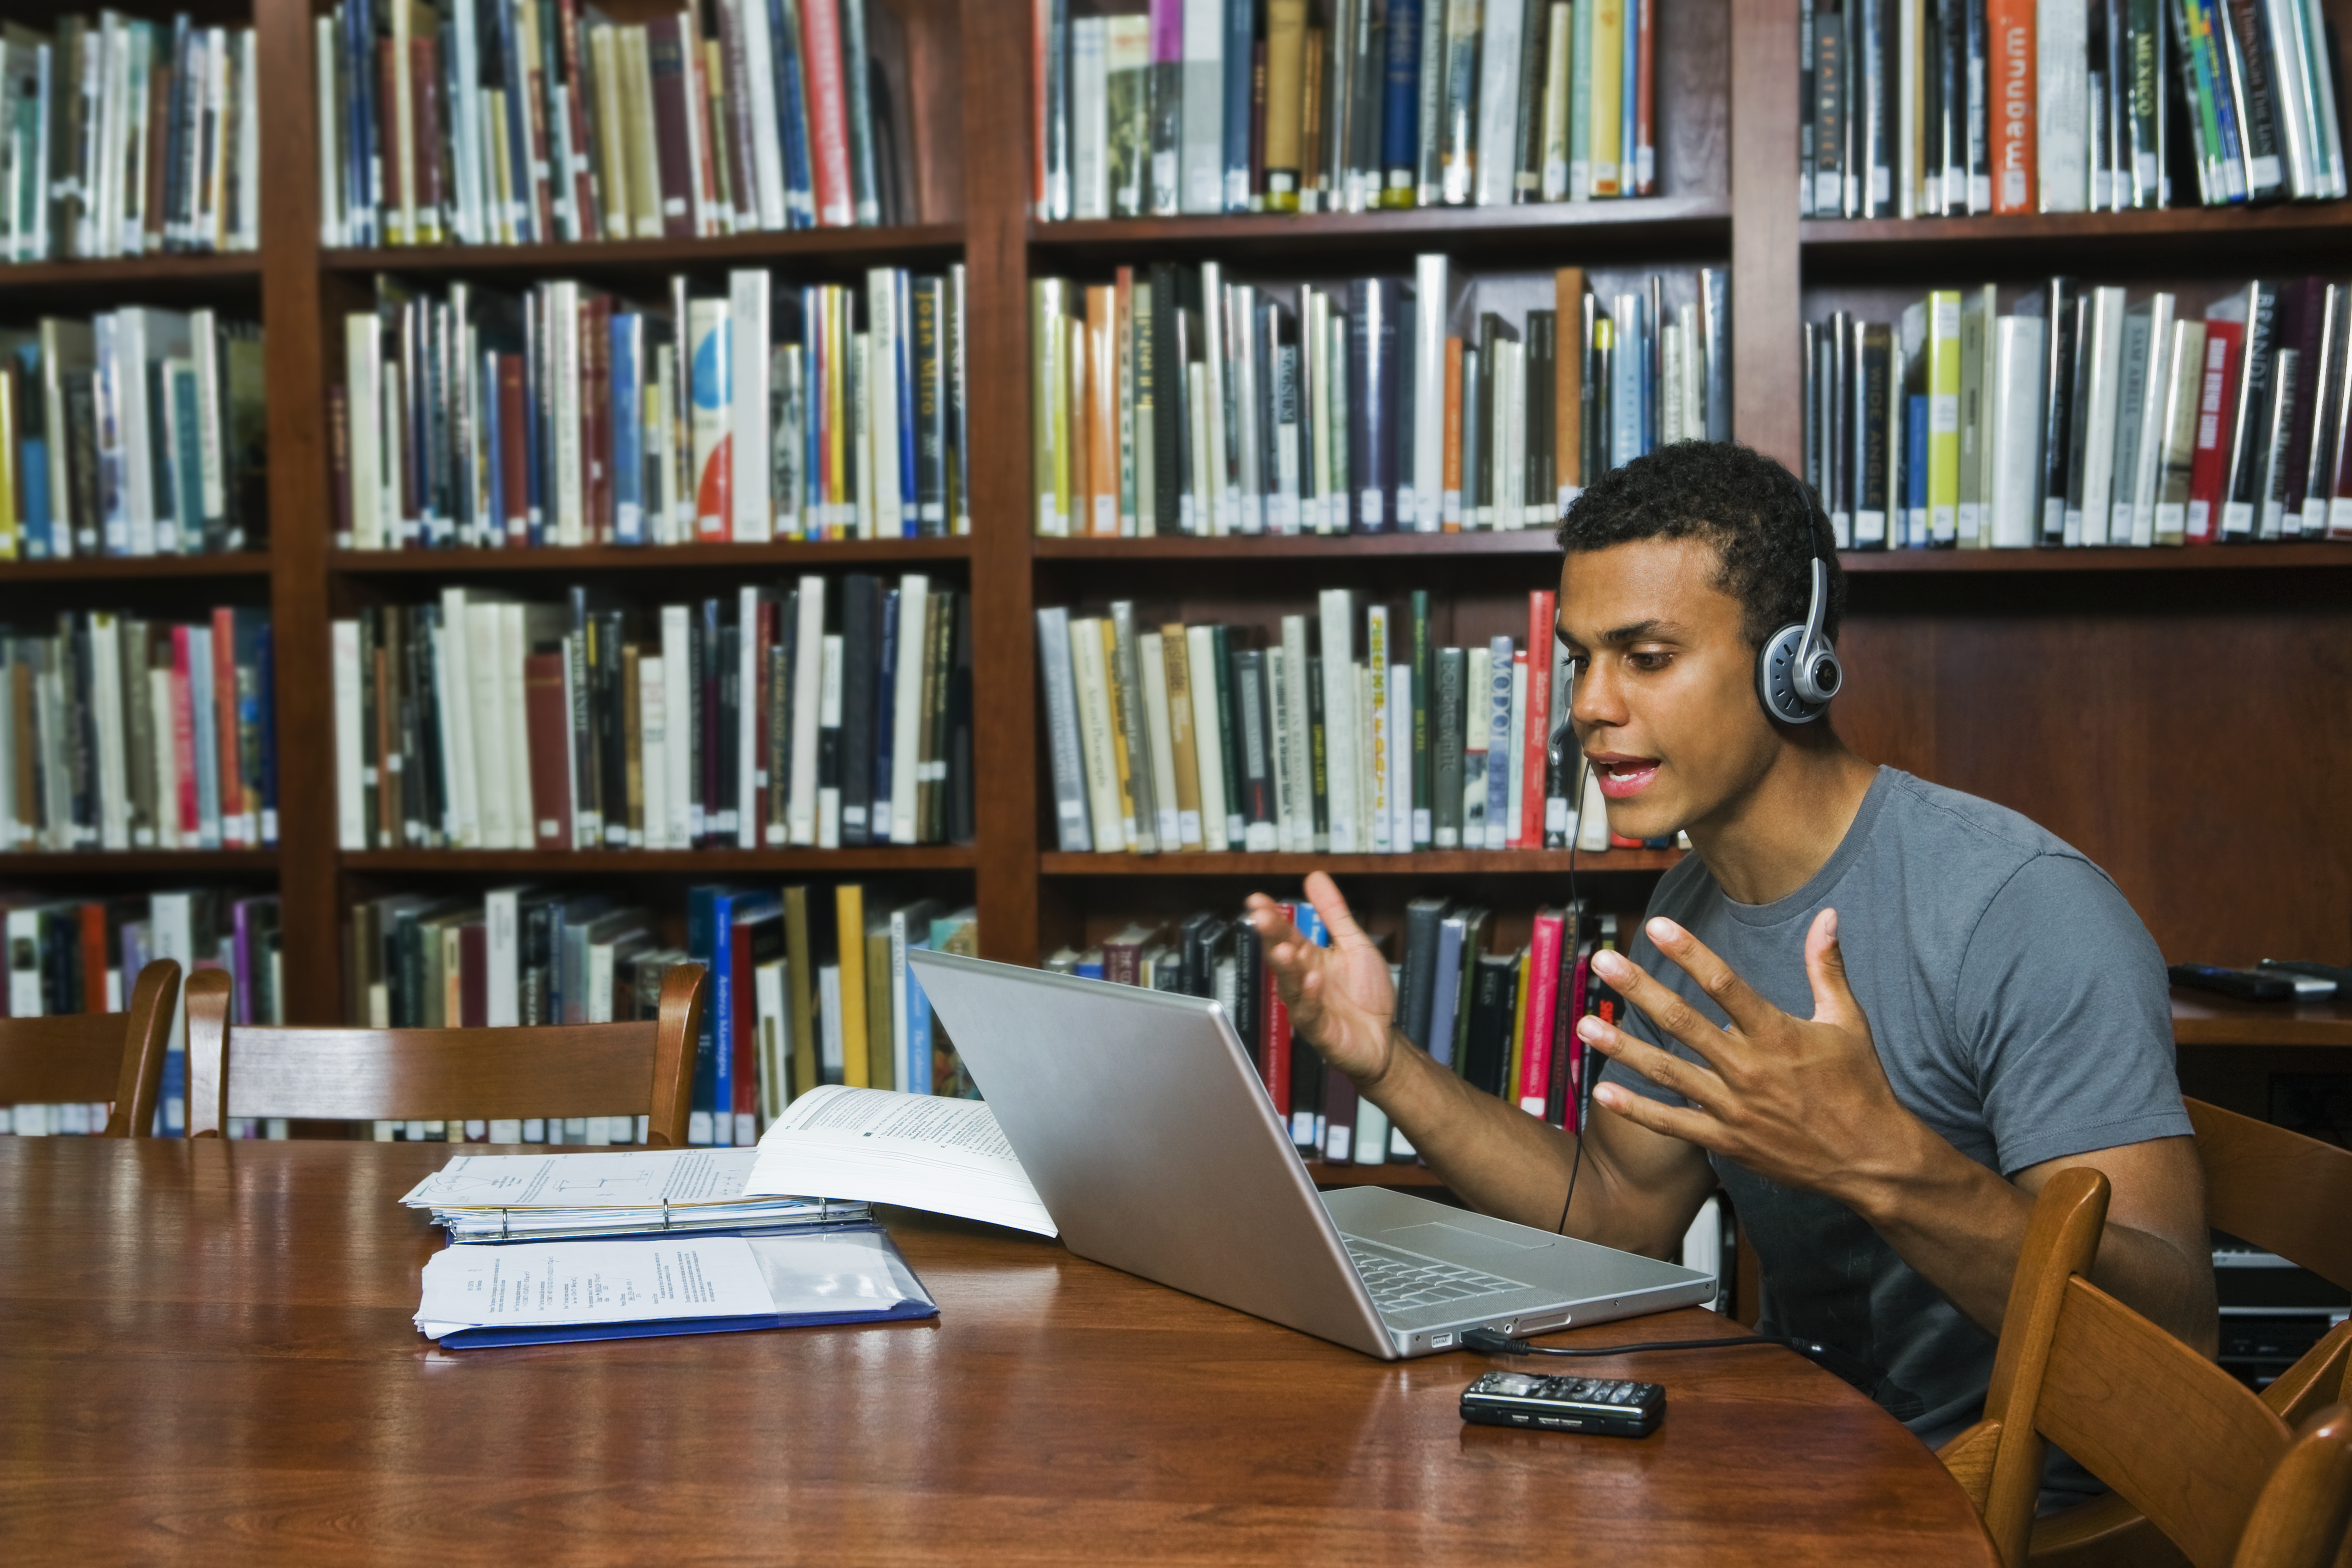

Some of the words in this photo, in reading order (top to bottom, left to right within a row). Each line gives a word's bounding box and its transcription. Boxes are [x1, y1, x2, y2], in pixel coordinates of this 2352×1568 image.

[2136, 32, 2153, 117] MEXICO
[2006, 27, 2026, 171] magnum
[876, 291, 889, 350] GOYA
[915, 292, 936, 346] Joan
[2131, 327, 2143, 362] SAM
[2249, 293, 2276, 391] BRANDT
[1121, 305, 1131, 481] YOKOHAMA
[1280, 347, 1295, 422] MAGNUM
[1869, 366, 1883, 421] WIDE
[2125, 366, 2141, 415] ABELL
[1868, 429, 1882, 505] ANGLE
[572, 630, 589, 734] REMBRANDT
[773, 655, 787, 739] REMBRANDT
[1087, 687, 1099, 704] Art
[1122, 684, 1133, 709] First
[1244, 674, 1258, 718] ANSEL
[1288, 659, 1299, 708] ARNOLD
[1534, 670, 1548, 714] Mathew
[1051, 686, 1068, 784] PHOTOGRAPHY
[1091, 707, 1101, 725] and
[1126, 711, 1136, 731] and
[1415, 709, 1425, 754] BRAZIL
[1441, 660, 1456, 773] BOURKE-WHITE
[1532, 716, 1546, 750] Brady
[1092, 726, 1108, 788] Photography
[1128, 731, 1137, 754] Last
[1249, 726, 1263, 773] ADAMS
[1313, 724, 1324, 756] EDWARD
[1293, 731, 1305, 815] RETROSPECT
[1315, 766, 1325, 796] CURTIS
[1568, 915, 1577, 932] NEW
[893, 922, 904, 977] MORANDI
[1241, 942, 1250, 979] HISTORY
[1566, 938, 1575, 962] YORK
[716, 974, 730, 1015] Andrea
[1241, 982, 1250, 993] OF
[1240, 997, 1249, 1032] WOMEN
[1270, 994, 1279, 1033] CAMERA
[715, 1019, 730, 1079] Mantegna
[915, 1029, 924, 1045] The
[1270, 1034, 1278, 1047] AS
[1556, 1024, 1566, 1088] PHOTOGRAPHY
[913, 1051, 924, 1080] Cabinet
